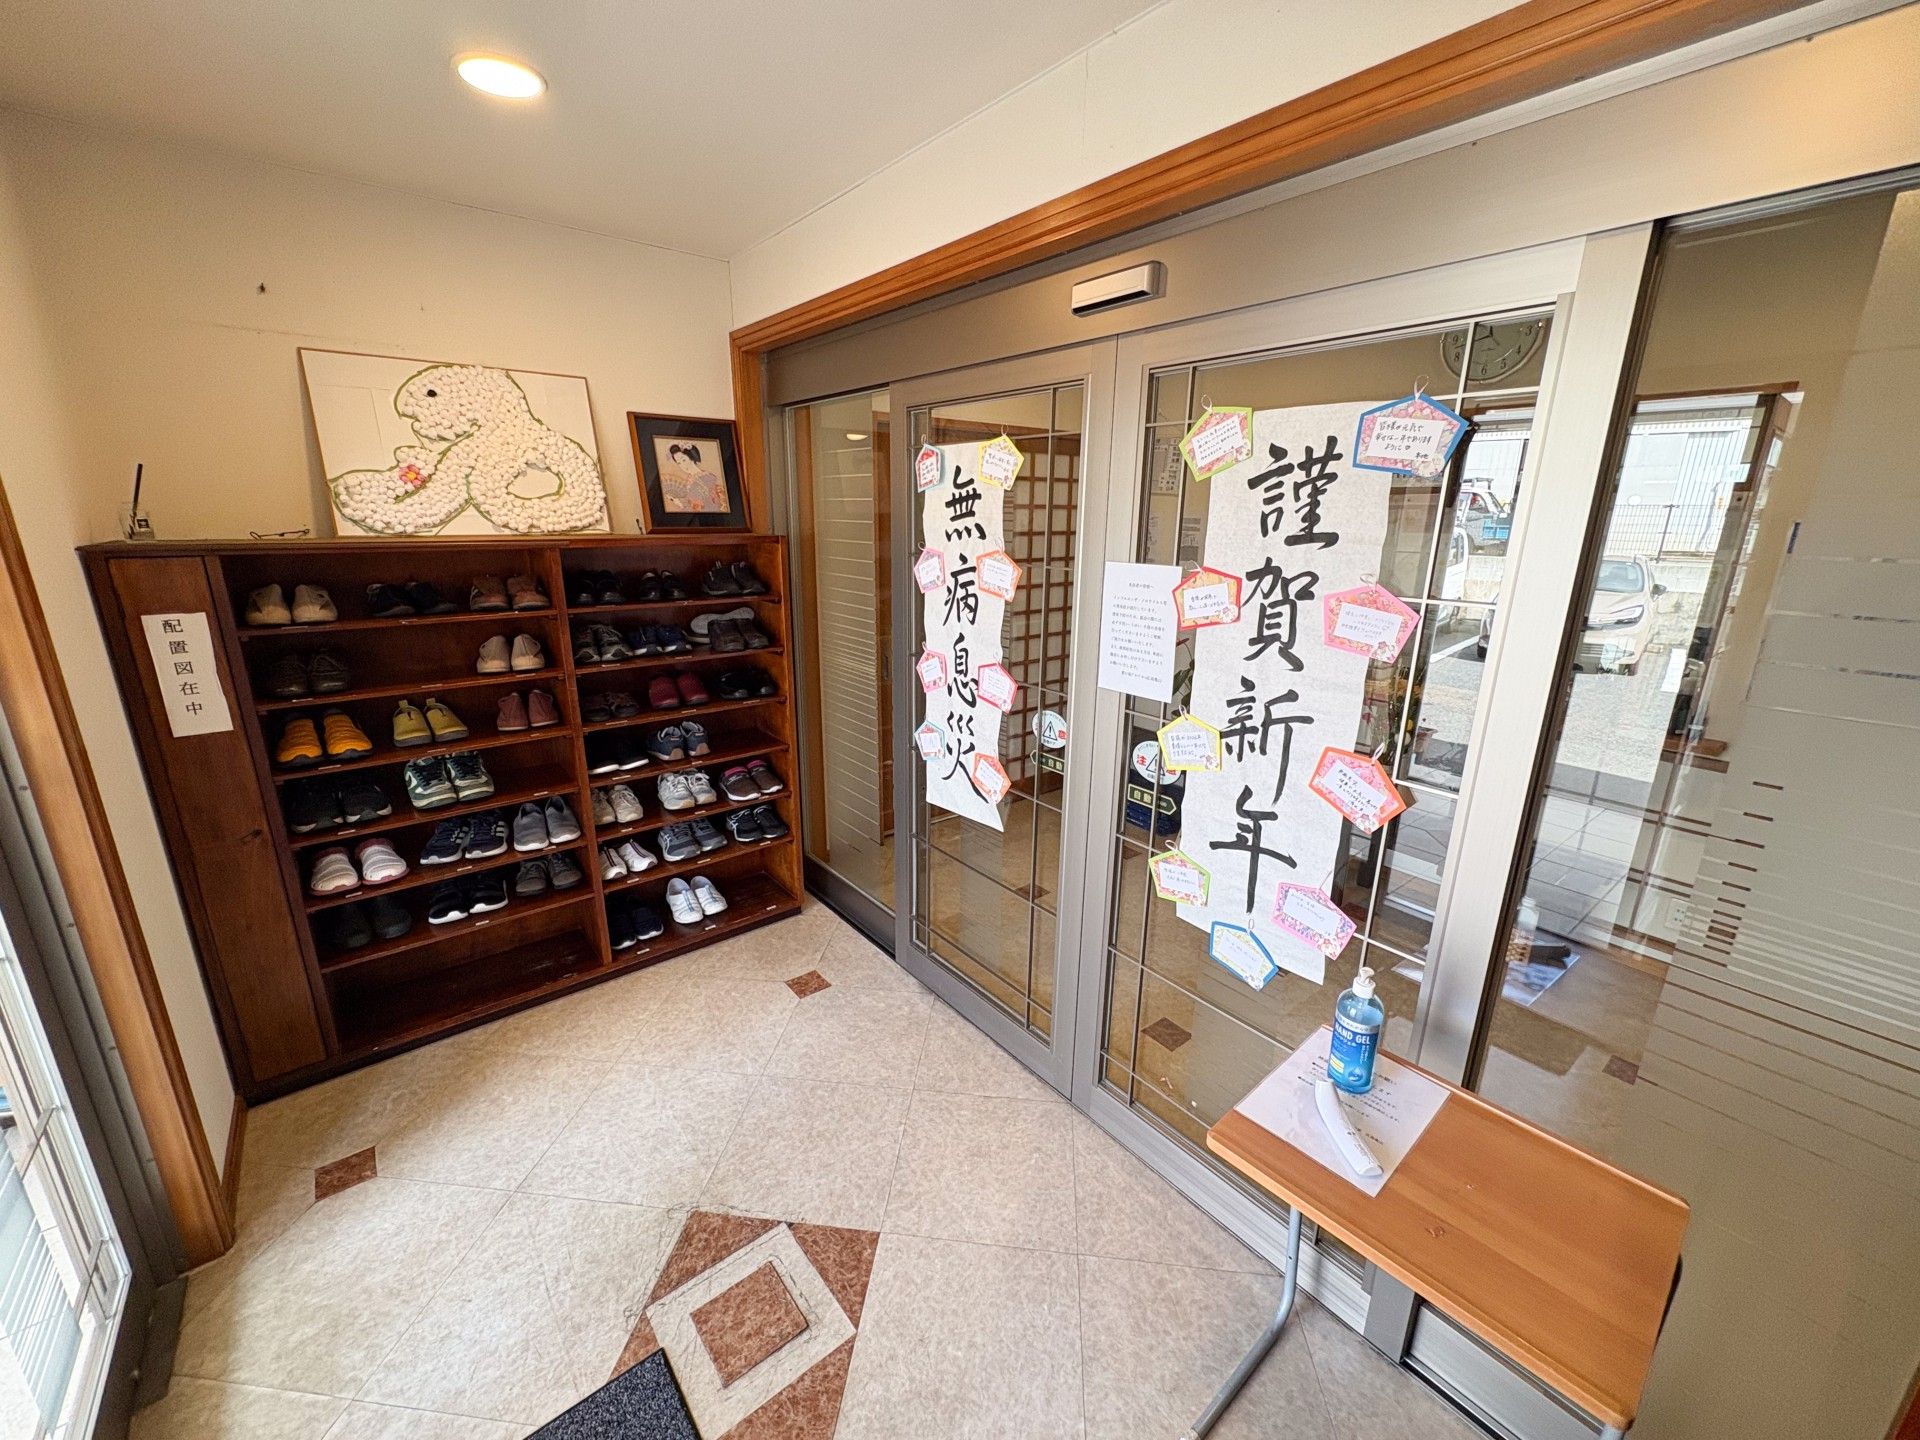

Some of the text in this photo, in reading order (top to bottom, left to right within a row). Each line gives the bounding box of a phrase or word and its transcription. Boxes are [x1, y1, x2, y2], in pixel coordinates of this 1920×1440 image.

[161, 619, 202, 715] 配置図在中
[943, 465, 989, 804] 無病息災
[1209, 435, 1344, 914] 謹賀新年
[1355, 1035, 1371, 1045] GEL
